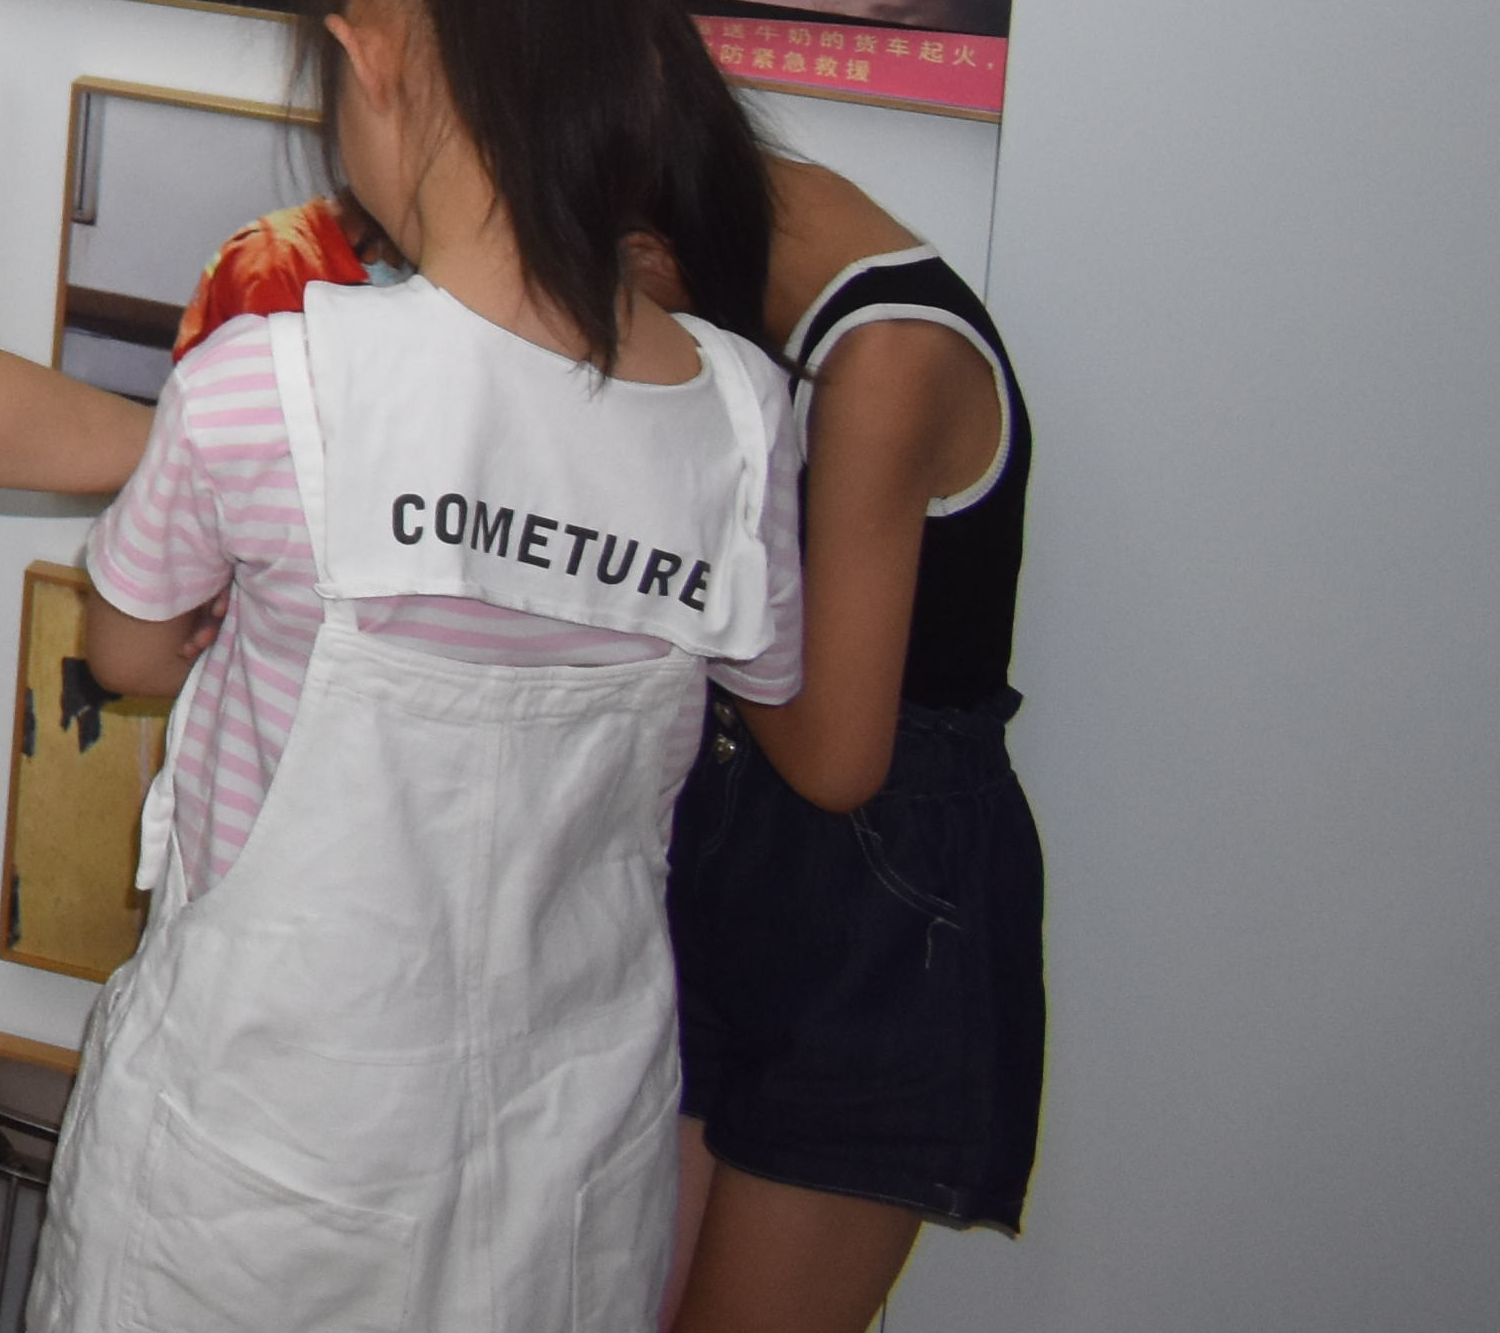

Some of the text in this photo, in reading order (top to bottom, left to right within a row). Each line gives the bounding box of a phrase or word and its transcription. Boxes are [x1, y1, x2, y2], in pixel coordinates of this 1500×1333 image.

[707, 43, 872, 83] 防紧急救援
[391, 492, 712, 612] COMETURE
